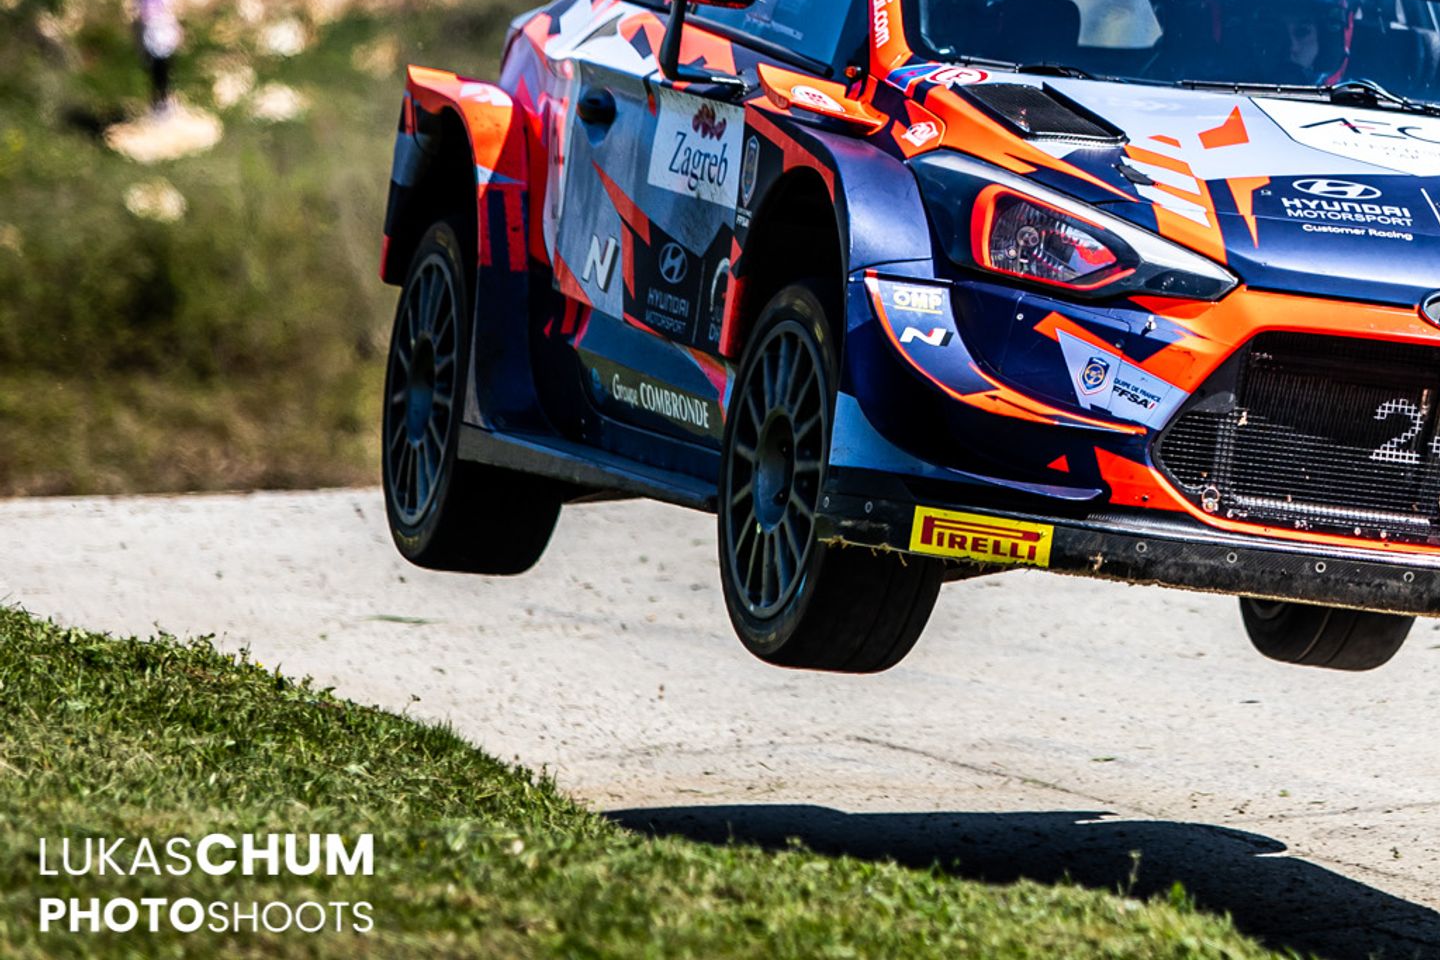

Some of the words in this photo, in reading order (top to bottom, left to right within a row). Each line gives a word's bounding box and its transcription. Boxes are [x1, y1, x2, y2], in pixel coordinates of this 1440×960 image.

[668, 131, 728, 191] Zagreb
[1281, 197, 1412, 218] HYUNDAI
[1286, 209, 1414, 227] MOTORSPORT
[1302, 224, 1366, 236] Customer
[1368, 227, 1414, 241] Racing
[647, 287, 690, 318] HYUNDAI
[893, 290, 943, 311] OMP
[640, 382, 710, 428] COMBRONDE
[920, 515, 1041, 561] PIRELLI
